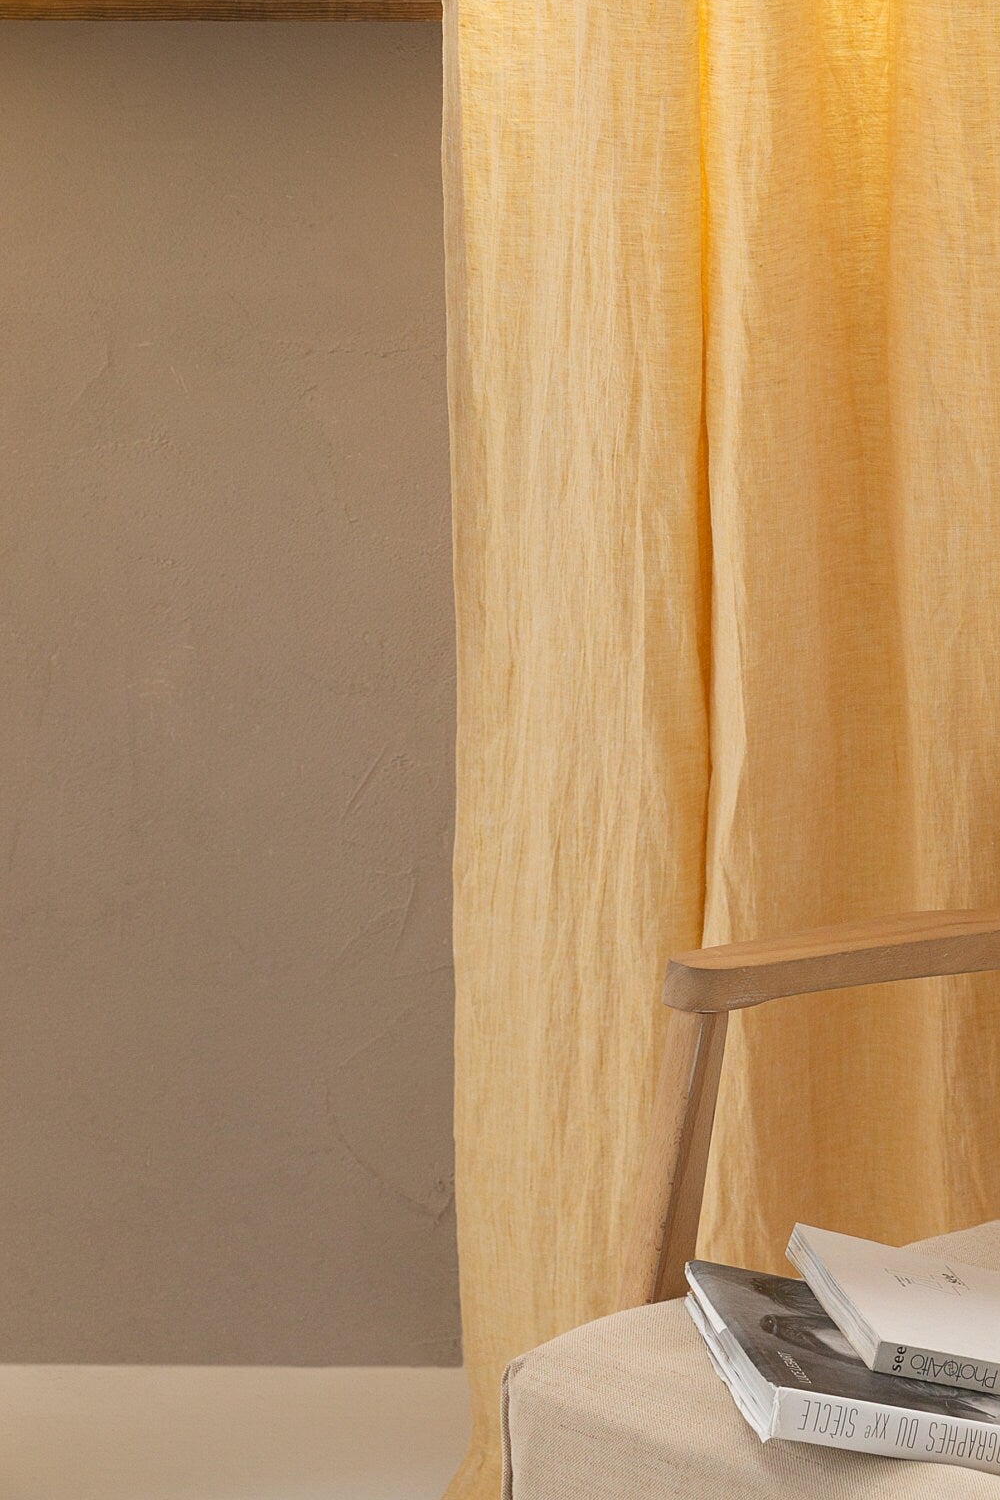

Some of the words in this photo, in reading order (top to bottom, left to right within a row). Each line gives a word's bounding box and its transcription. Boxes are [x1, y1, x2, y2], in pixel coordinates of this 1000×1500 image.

[892, 1346, 908, 1373] see
[797, 1399, 859, 1440] SIÈCLE
[895, 1417, 920, 1449] DU
